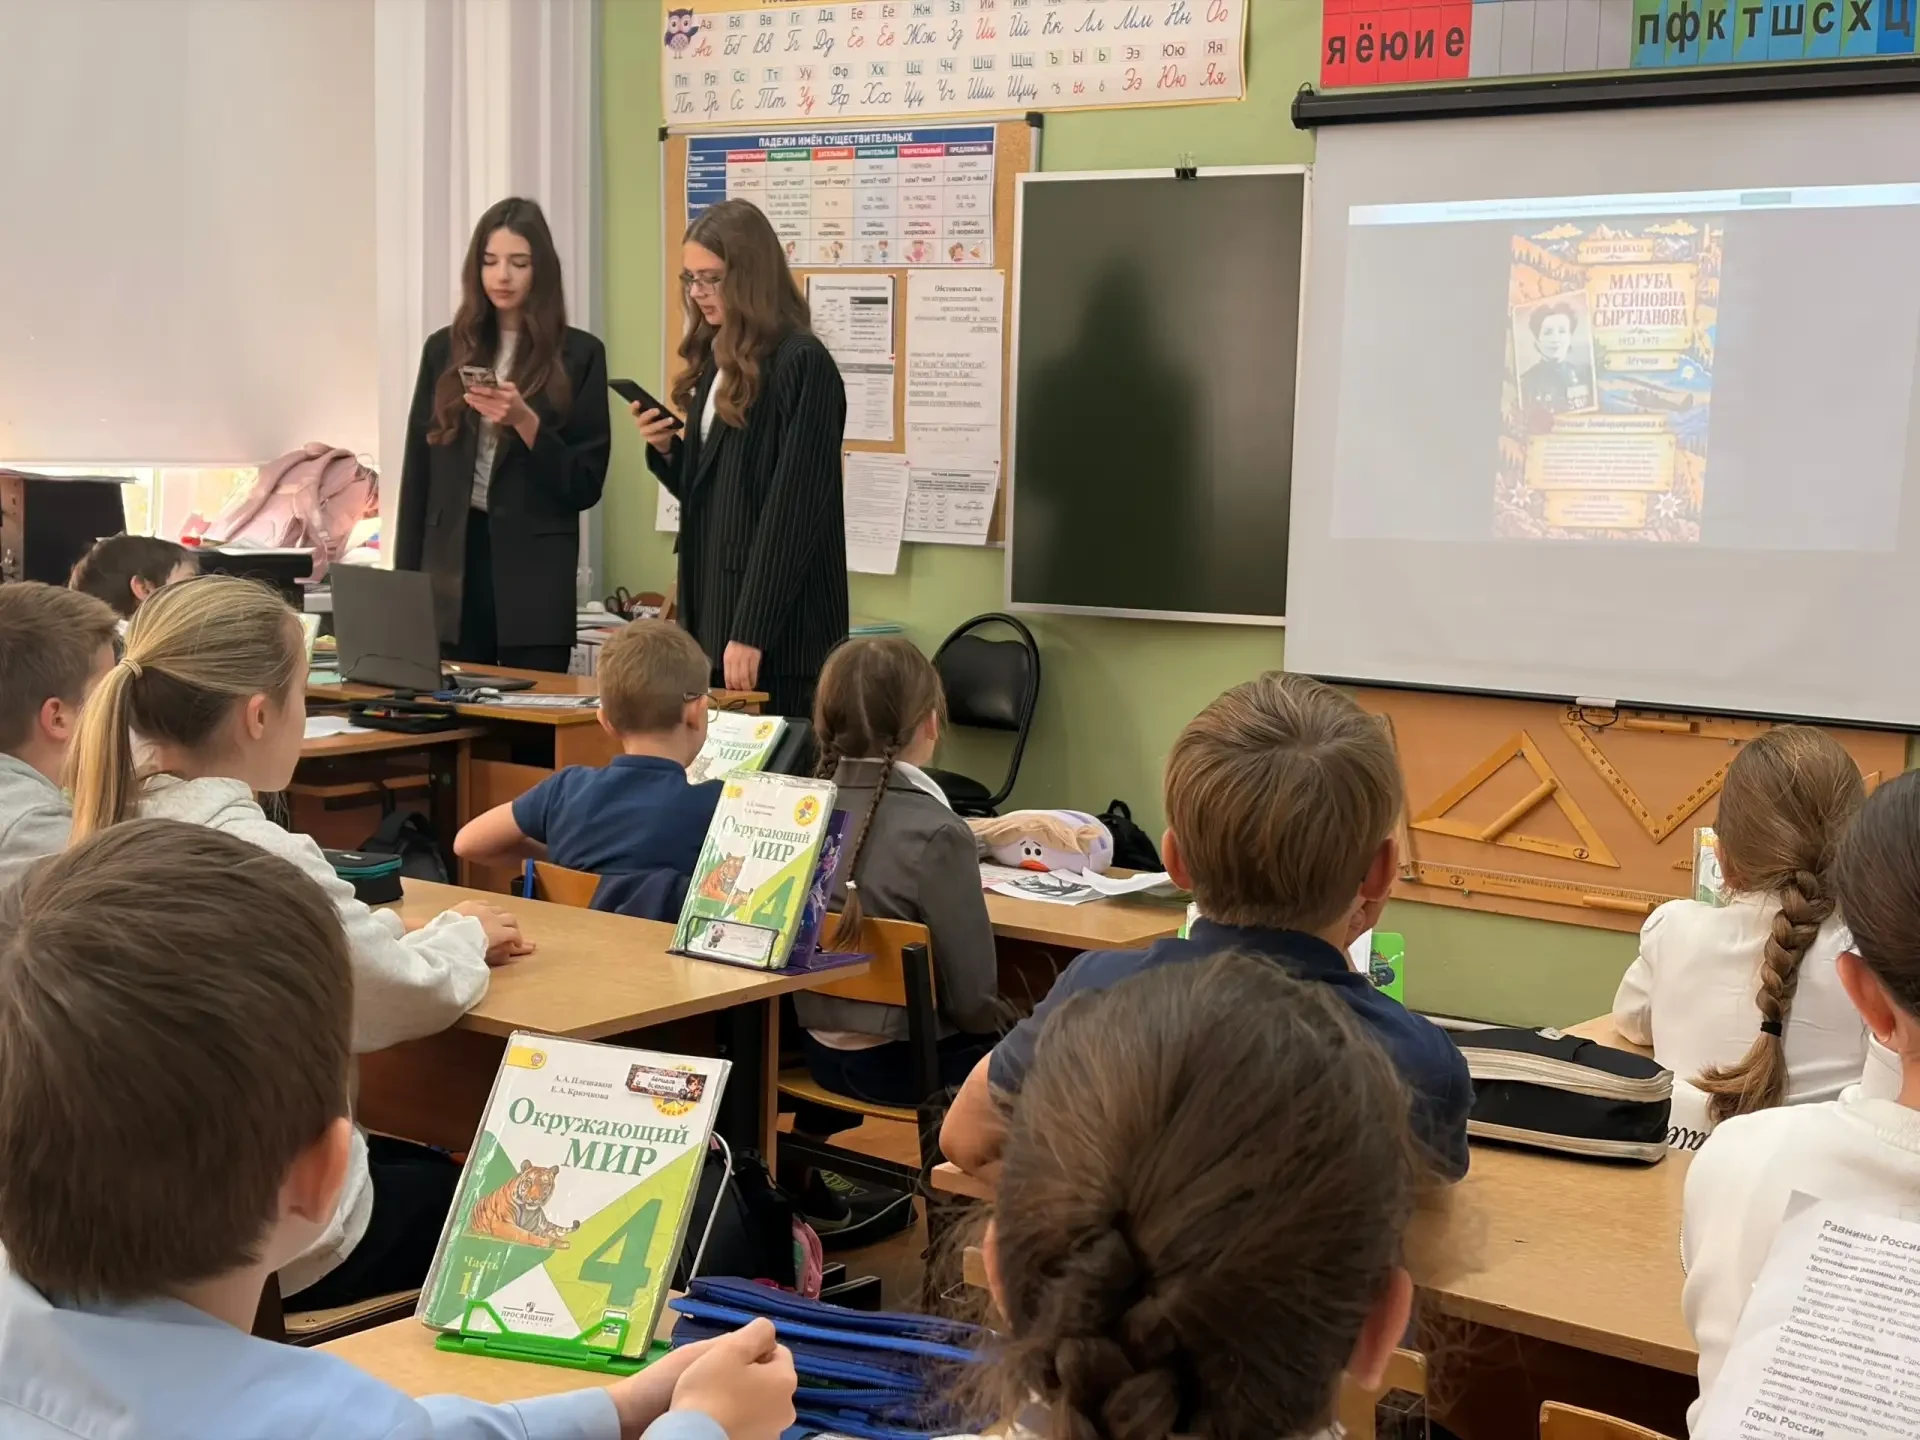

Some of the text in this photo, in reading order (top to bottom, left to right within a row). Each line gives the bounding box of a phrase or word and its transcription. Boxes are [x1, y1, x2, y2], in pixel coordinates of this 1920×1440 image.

[700, 19, 712, 29] Аа
[729, 17, 740, 27] Бб
[760, 16, 772, 25] Вв
[791, 13, 801, 22] Гг
[818, 11, 833, 22] Дд
[852, 8, 863, 19] Ее
[914, 4, 930, 15] Жж
[950, 1, 960, 12] Зз
[692, 39, 712, 58] Аа
[723, 35, 747, 55] Бб
[753, 32, 774, 53] Вв
[784, 30, 802, 51] Гг
[813, 31, 835, 58] Дд
[847, 29, 864, 48] Ее
[903, 23, 936, 45] Жж
[947, 20, 962, 50] Зз
[976, 18, 996, 40] Ии
[1009, 12, 1030, 37] Йй
[1042, 12, 1063, 34] Кк
[1074, 9, 1104, 33] Лл
[1114, 6, 1153, 31] Мм
[1164, 0, 1192, 26] Нн
[1206, 0, 1228, 24] Оо
[675, 75, 688, 86] Пп
[705, 73, 716, 85] Рр
[734, 71, 744, 81] Сс
[767, 70, 778, 80] Тт
[800, 68, 812, 80] Уу
[832, 65, 849, 78] Фф
[871, 63, 884, 75] Хх
[907, 63, 920, 74] Цц
[940, 60, 952, 71] Чч
[973, 57, 992, 69] Шш
[1012, 54, 1033, 68] Щщ
[1125, 47, 1140, 59] Ээ
[1163, 44, 1185, 58] Юю
[1208, 41, 1223, 54] Яя
[672, 92, 694, 113] Пп
[703, 91, 720, 119] Рр
[730, 89, 744, 111] Сс
[797, 86, 816, 114] Уу
[828, 84, 850, 113] Фф
[860, 82, 892, 105] Хх
[904, 81, 925, 108] Цц
[936, 80, 955, 101] Чч
[967, 77, 995, 100] Шш
[1007, 75, 1038, 103] Щщ
[1122, 68, 1142, 90] Ээ
[1157, 64, 1186, 88] Юю
[1200, 62, 1227, 86] Яя
[759, 132, 912, 148] ПАДЕЖИ ИМЁН СУЩЕСТВИТЕЛЬНЫХ
[1609, 272, 1673, 289] МАГУБА
[1596, 291, 1686, 308] ГУСЕЙНОВНА
[1594, 308, 1688, 327] СЫРТЛАНОВА
[750, 840, 795, 862] МИР
[571, 1077, 612, 1088] Плешаков
[568, 1088, 608, 1100] Крючкова
[509, 1097, 690, 1146] Окружающий
[560, 1138, 658, 1176] МИР
[1822, 1219, 1877, 1242] Равнины
[464, 1255, 498, 1270] Часть
[578, 1198, 664, 1307] 4
[458, 1272, 472, 1296] 1
[1898, 1275, 1920, 1286] Росс
[501, 1310, 554, 1324] ПРОСВЕЩЕНИЕ
[1744, 1406, 1824, 1437] Горы России
